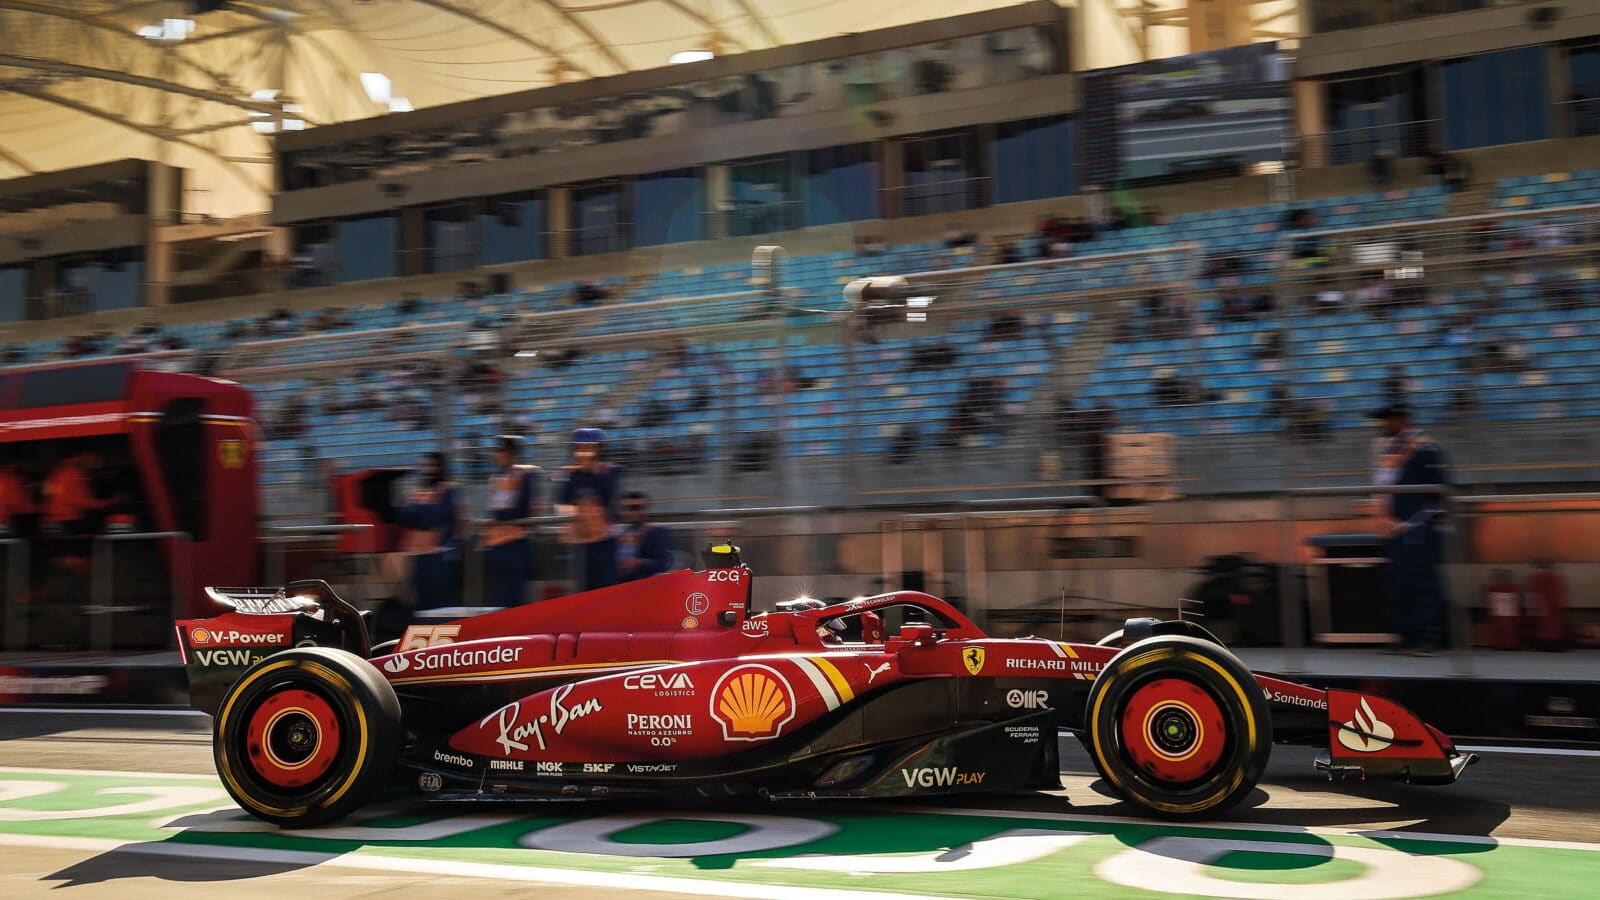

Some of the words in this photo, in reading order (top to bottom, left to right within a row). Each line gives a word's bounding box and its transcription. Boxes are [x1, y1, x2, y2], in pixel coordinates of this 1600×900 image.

[708, 570, 740, 582] ZCG
[742, 620, 769, 630] aws
[210, 630, 285, 644] V-Power
[400, 624, 462, 651] 55
[196, 650, 251, 667] VGW
[413, 645, 523, 671] Santander
[1006, 658, 1066, 670] RICHARD
[627, 713, 693, 730] PERONI
[434, 750, 474, 768] brembo
[490, 760, 524, 770] MAHLE
[536, 761, 563, 772] NGK
[583, 763, 615, 773] SKF
[901, 766, 957, 788] VGW
[956, 772, 986, 785] PLAY
